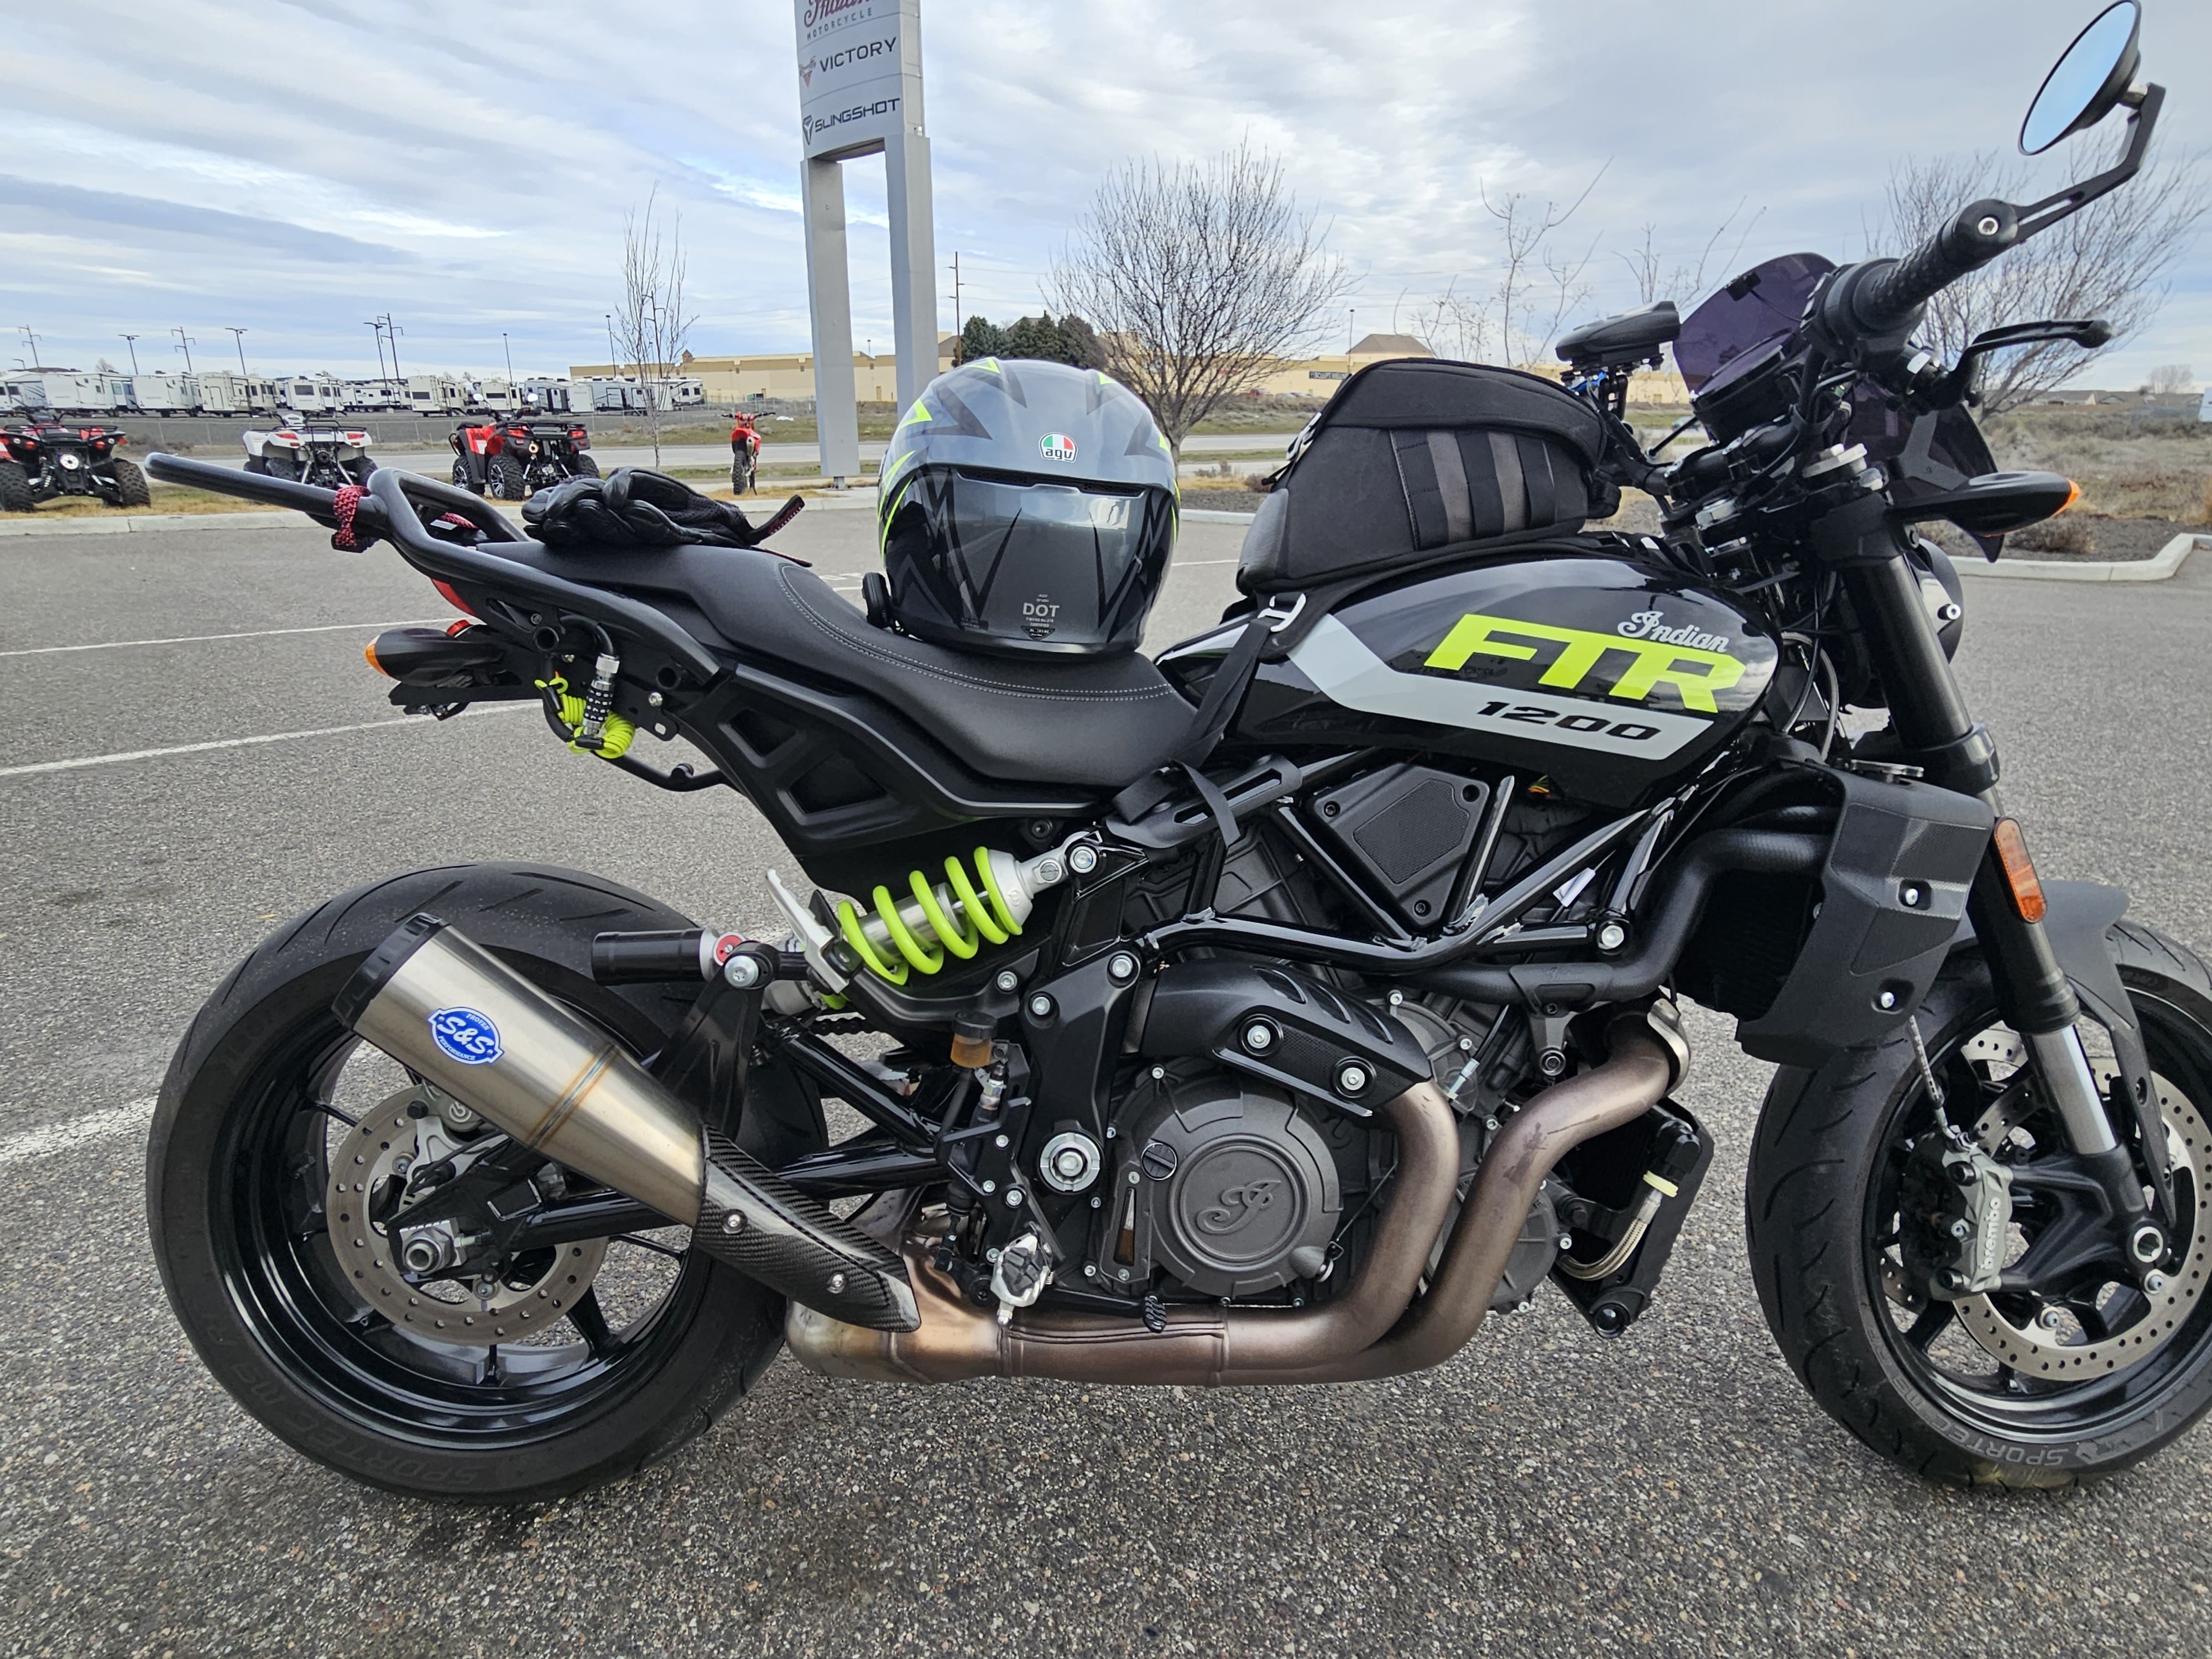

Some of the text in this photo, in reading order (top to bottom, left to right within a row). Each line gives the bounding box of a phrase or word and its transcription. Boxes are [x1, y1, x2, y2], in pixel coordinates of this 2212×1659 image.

[807, 8, 872, 41] MOTORCYCLE
[820, 36, 897, 73] VICTORY
[815, 98, 900, 133] SLINGSHOT
[1046, 448, 1072, 460] agv
[1022, 602, 1060, 617] DOT
[1618, 611, 1729, 653] Indian
[1424, 613, 1746, 713] FTR
[1477, 701, 1661, 740] 1200
[437, 1016, 495, 1054] S&S
[438, 1036, 476, 1061] PERFORMANCE
[1980, 1197, 2001, 1270] brembo
[1929, 1416, 2070, 1467] SPORTEC
